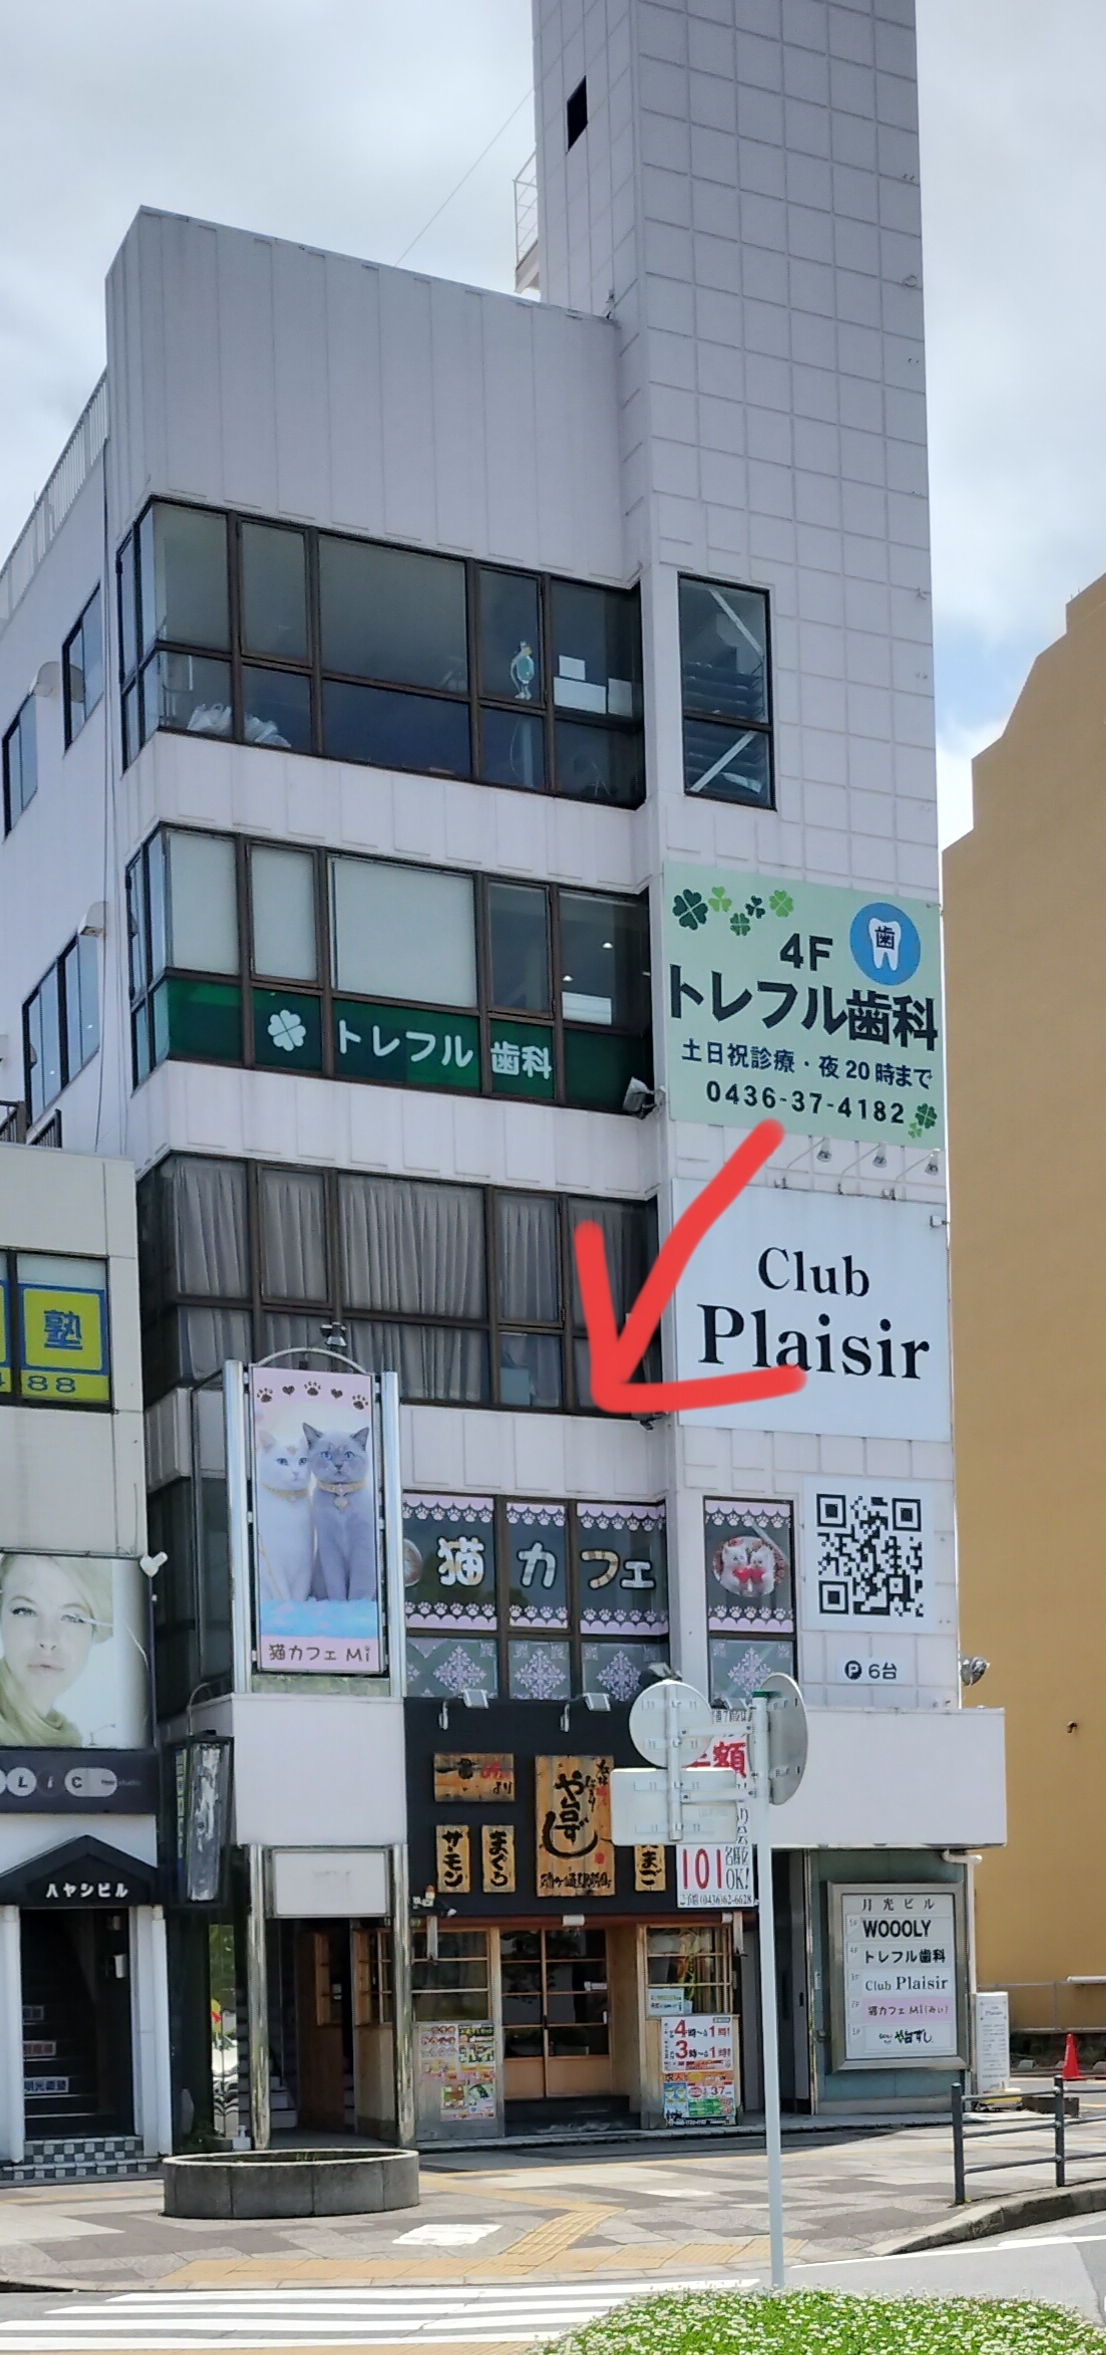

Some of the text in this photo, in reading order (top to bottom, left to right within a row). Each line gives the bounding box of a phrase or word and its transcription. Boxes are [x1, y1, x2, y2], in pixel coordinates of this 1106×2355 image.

[778, 933, 834, 972] 4F
[874, 925, 896, 951] 歯
[669, 963, 939, 1051] トレフル歯科
[706, 1080, 906, 1124] 0436-37-4182
[757, 1246, 870, 1297] Club
[43, 1310, 83, 1350] 塾
[696, 1304, 931, 1380] Plaisir
[436, 1534, 657, 1591] 猫カフェ
[268, 1643, 371, 1663] 猫カフェ Mi
[867, 1662, 898, 1681] 6台
[441, 1830, 464, 1888] サーモン
[489, 1830, 509, 1887] まぐろ
[640, 1844, 661, 1886] まご
[45, 1882, 130, 1899] ハヤシビル
[861, 1898, 935, 1912] 月光ビル
[862, 1919, 932, 1938] WOOOLY
[864, 1948, 946, 1964] トレフル歯科
[865, 1975, 949, 1992] Club Plaisir
